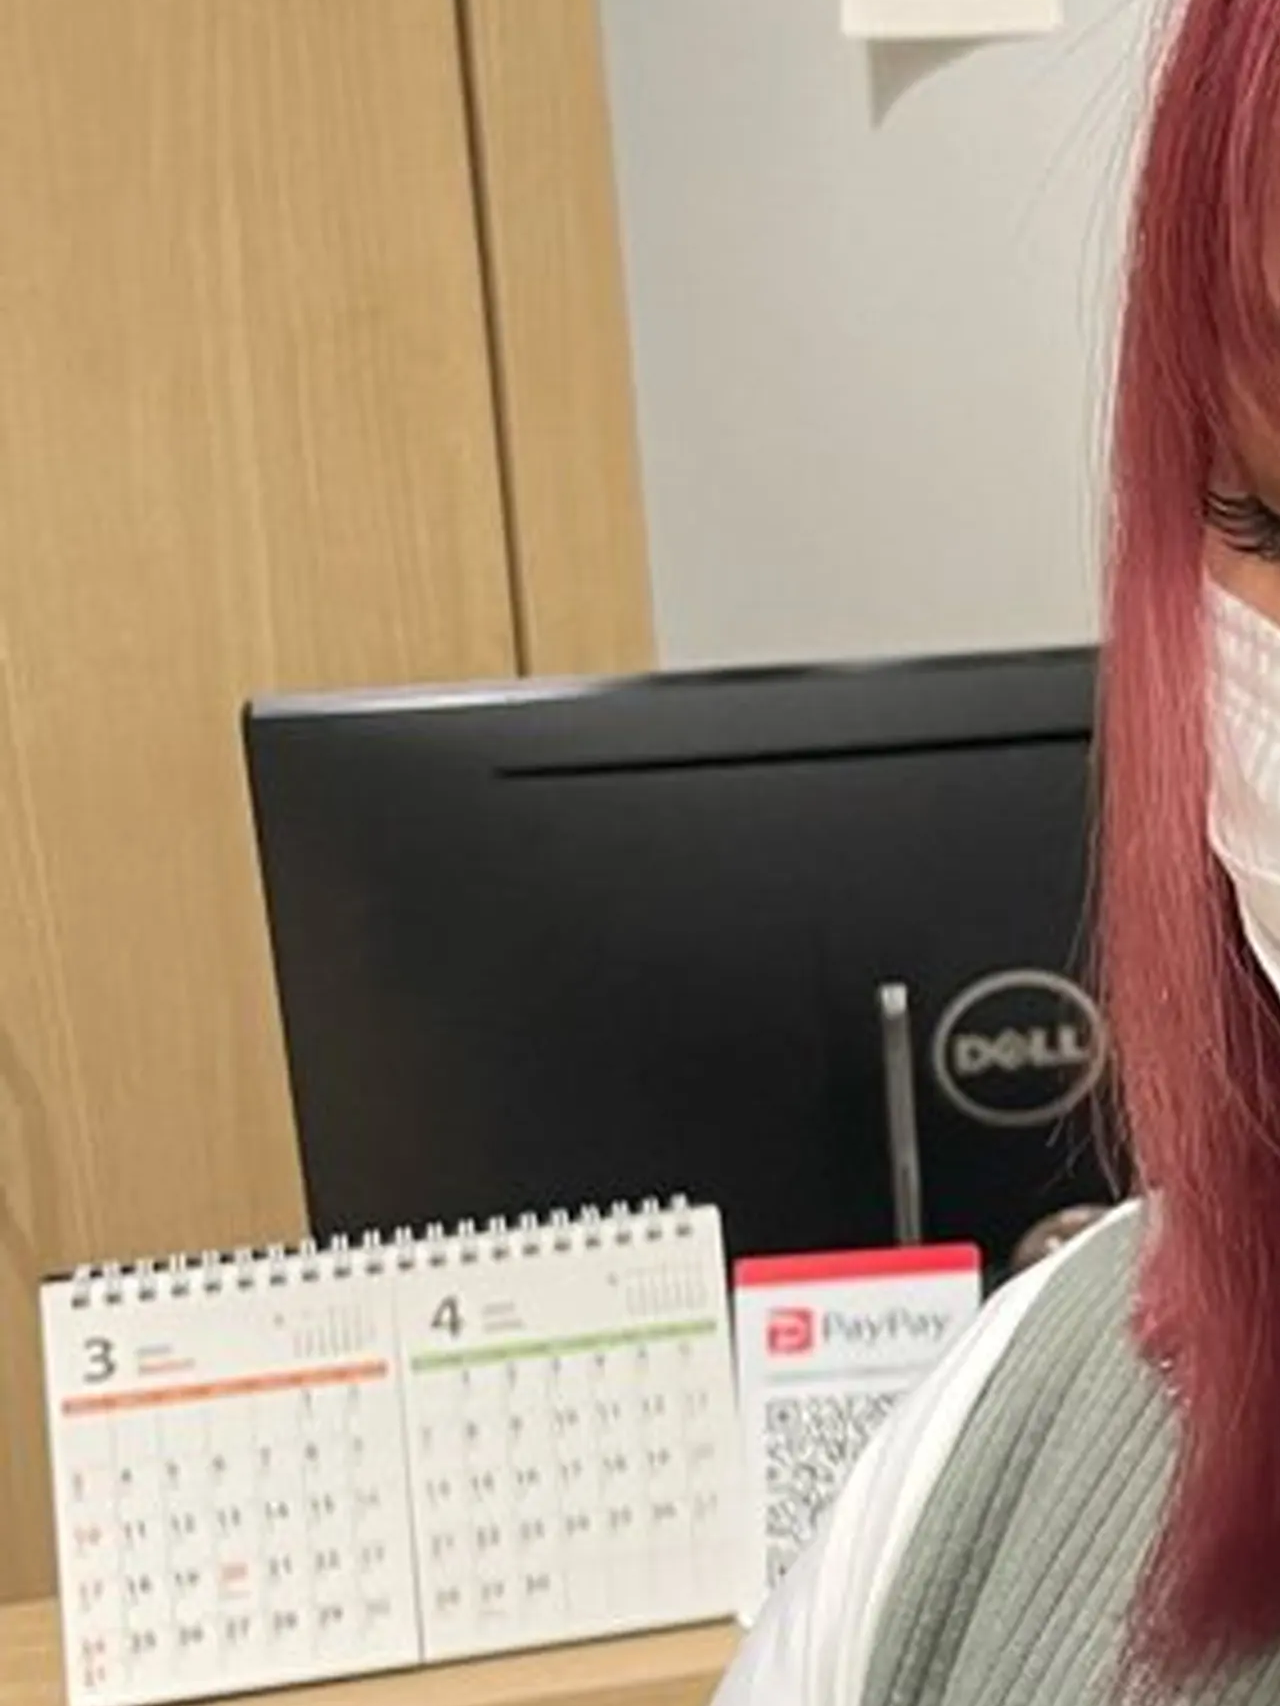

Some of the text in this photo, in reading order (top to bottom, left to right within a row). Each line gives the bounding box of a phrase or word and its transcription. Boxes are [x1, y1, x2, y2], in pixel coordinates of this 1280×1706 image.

[953, 1025, 1092, 1077] DELL
[430, 1294, 462, 1337] 4
[822, 1306, 947, 1346] PayPay
[83, 1336, 116, 1384] 3
